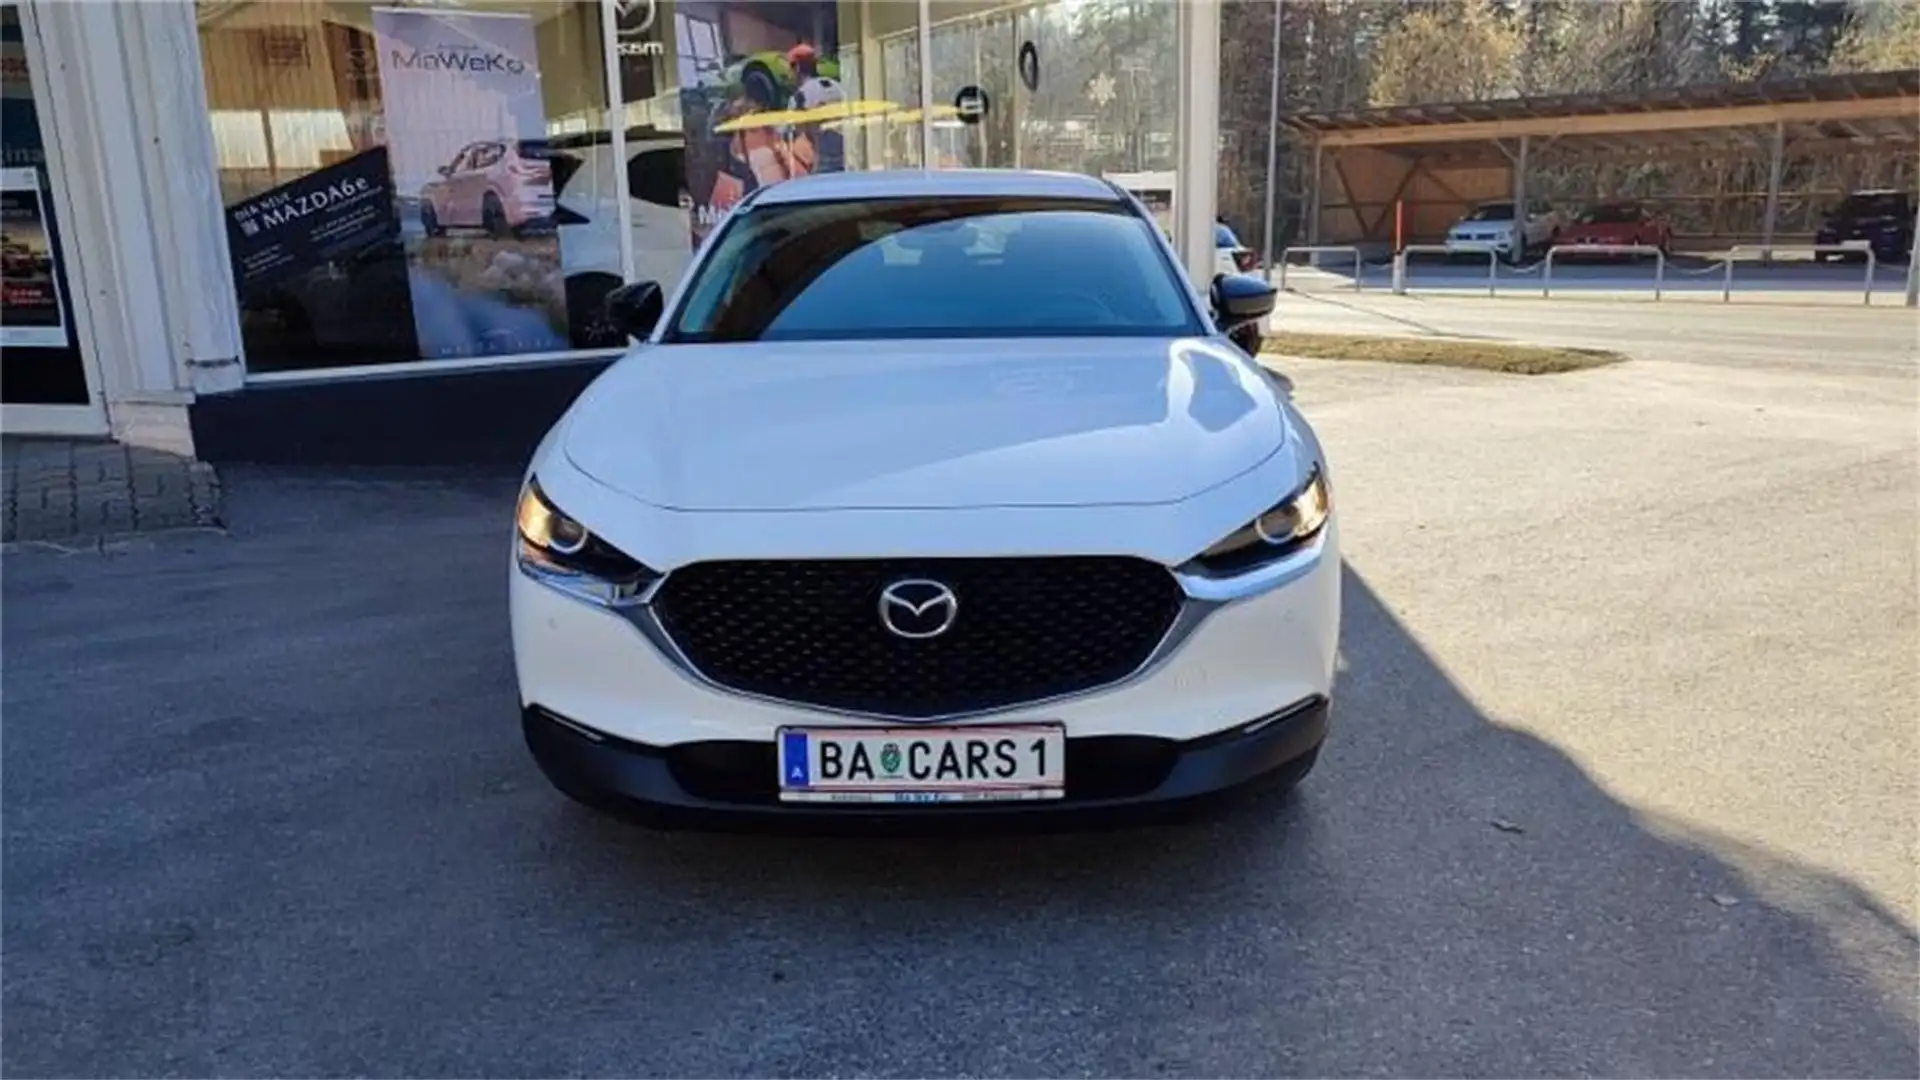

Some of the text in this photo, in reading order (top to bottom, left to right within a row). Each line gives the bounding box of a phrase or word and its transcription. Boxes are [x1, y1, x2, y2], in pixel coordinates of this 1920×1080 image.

[391, 49, 526, 74] MaWeKo
[262, 177, 370, 229] MAZDA6e
[791, 765, 804, 779] A
[820, 738, 1047, 780] BA CARS 1
